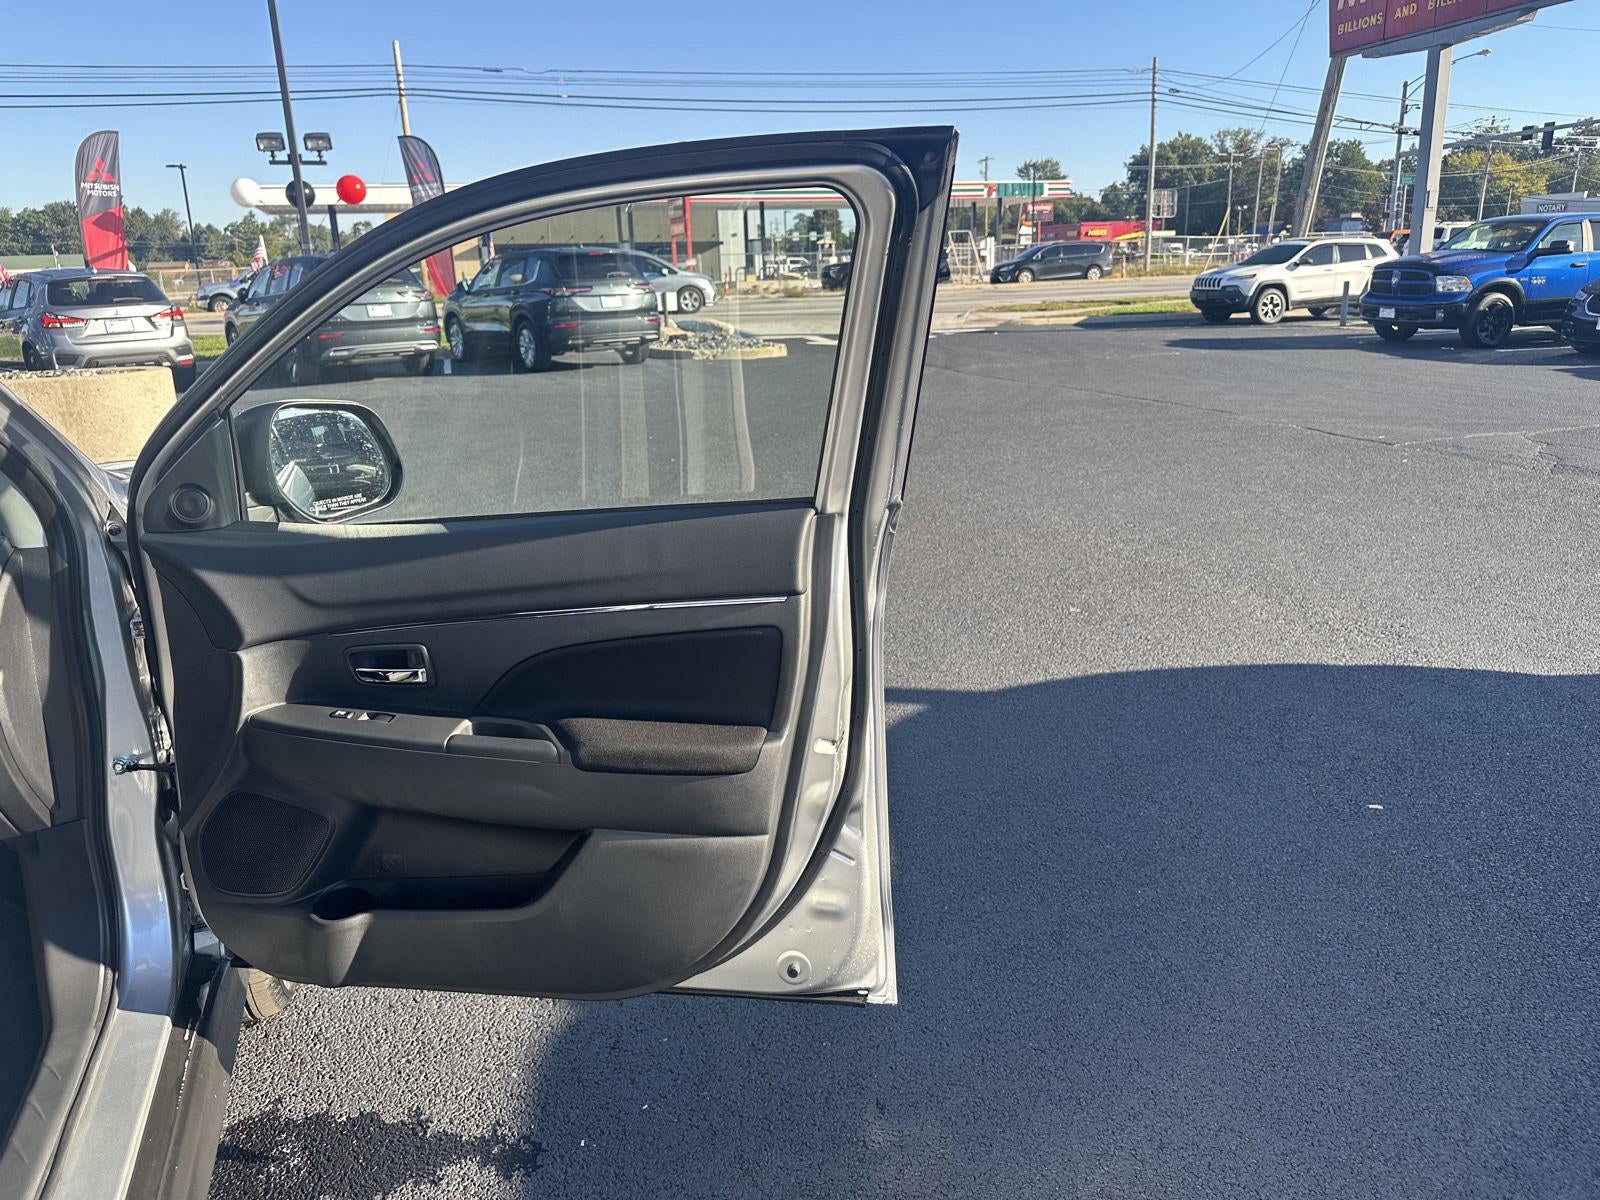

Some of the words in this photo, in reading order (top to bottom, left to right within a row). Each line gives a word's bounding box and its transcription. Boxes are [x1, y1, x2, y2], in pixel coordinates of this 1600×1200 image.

[1337, 12, 1383, 35] BILLIONS
[1394, 3, 1417, 20] AND
[1538, 203, 1566, 212] NOTARY
